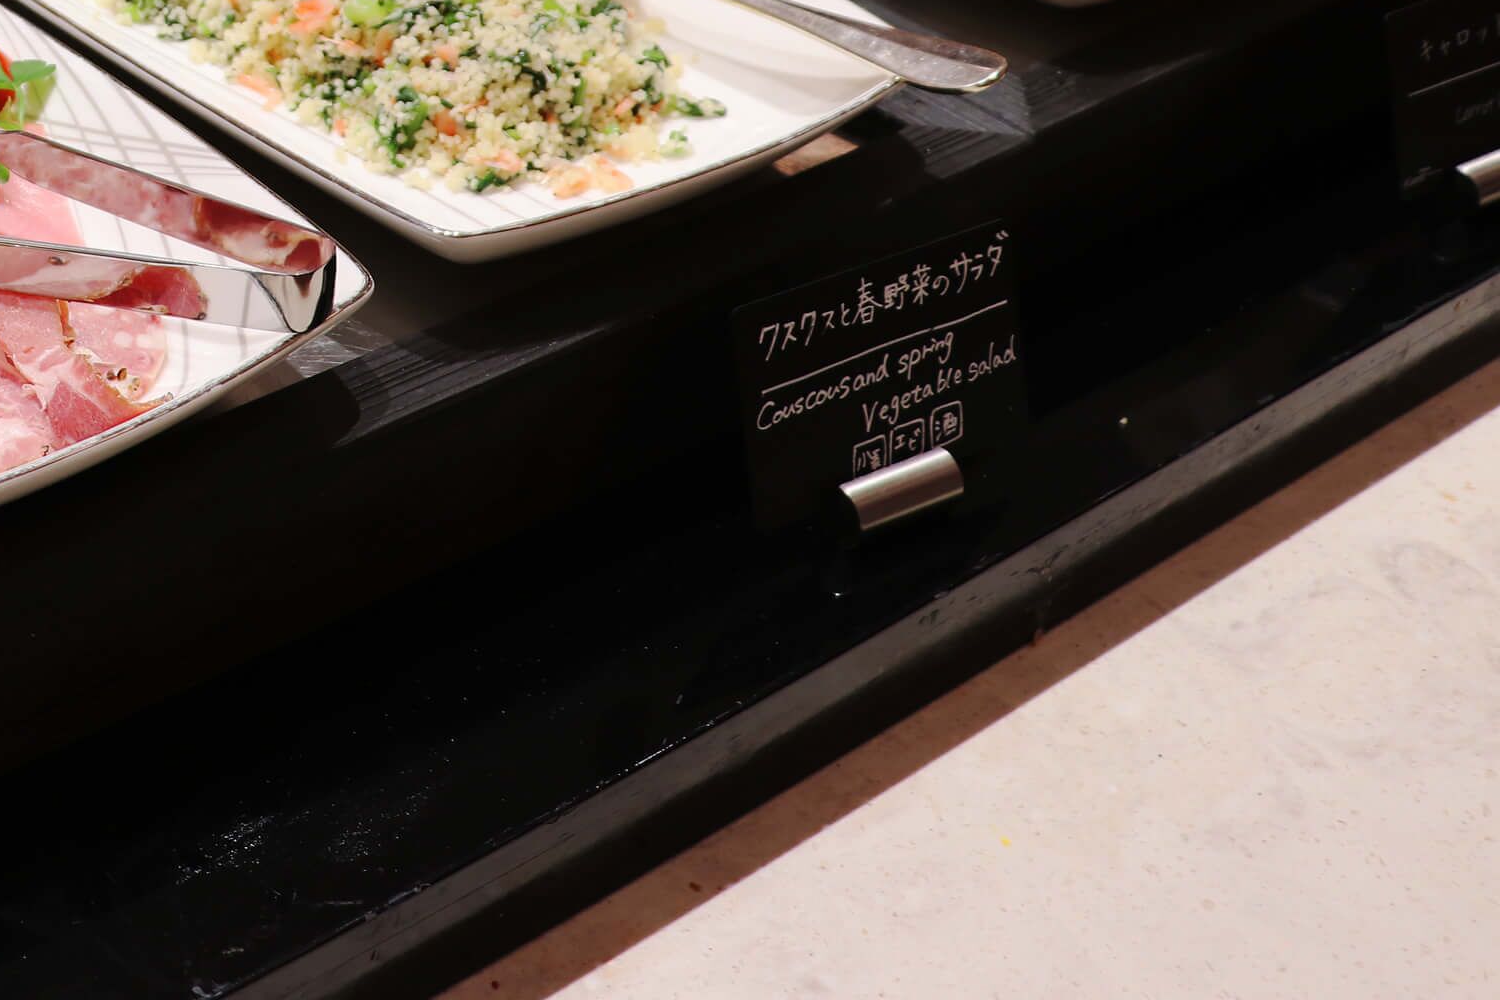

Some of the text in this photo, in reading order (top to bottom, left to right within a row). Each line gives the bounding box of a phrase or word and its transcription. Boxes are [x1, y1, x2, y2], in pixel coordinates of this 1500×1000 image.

[758, 229, 1010, 361] クスクスと春野菜のサラダ
[862, 334, 1017, 433] Vegetable salad
[898, 331, 954, 380] spring
